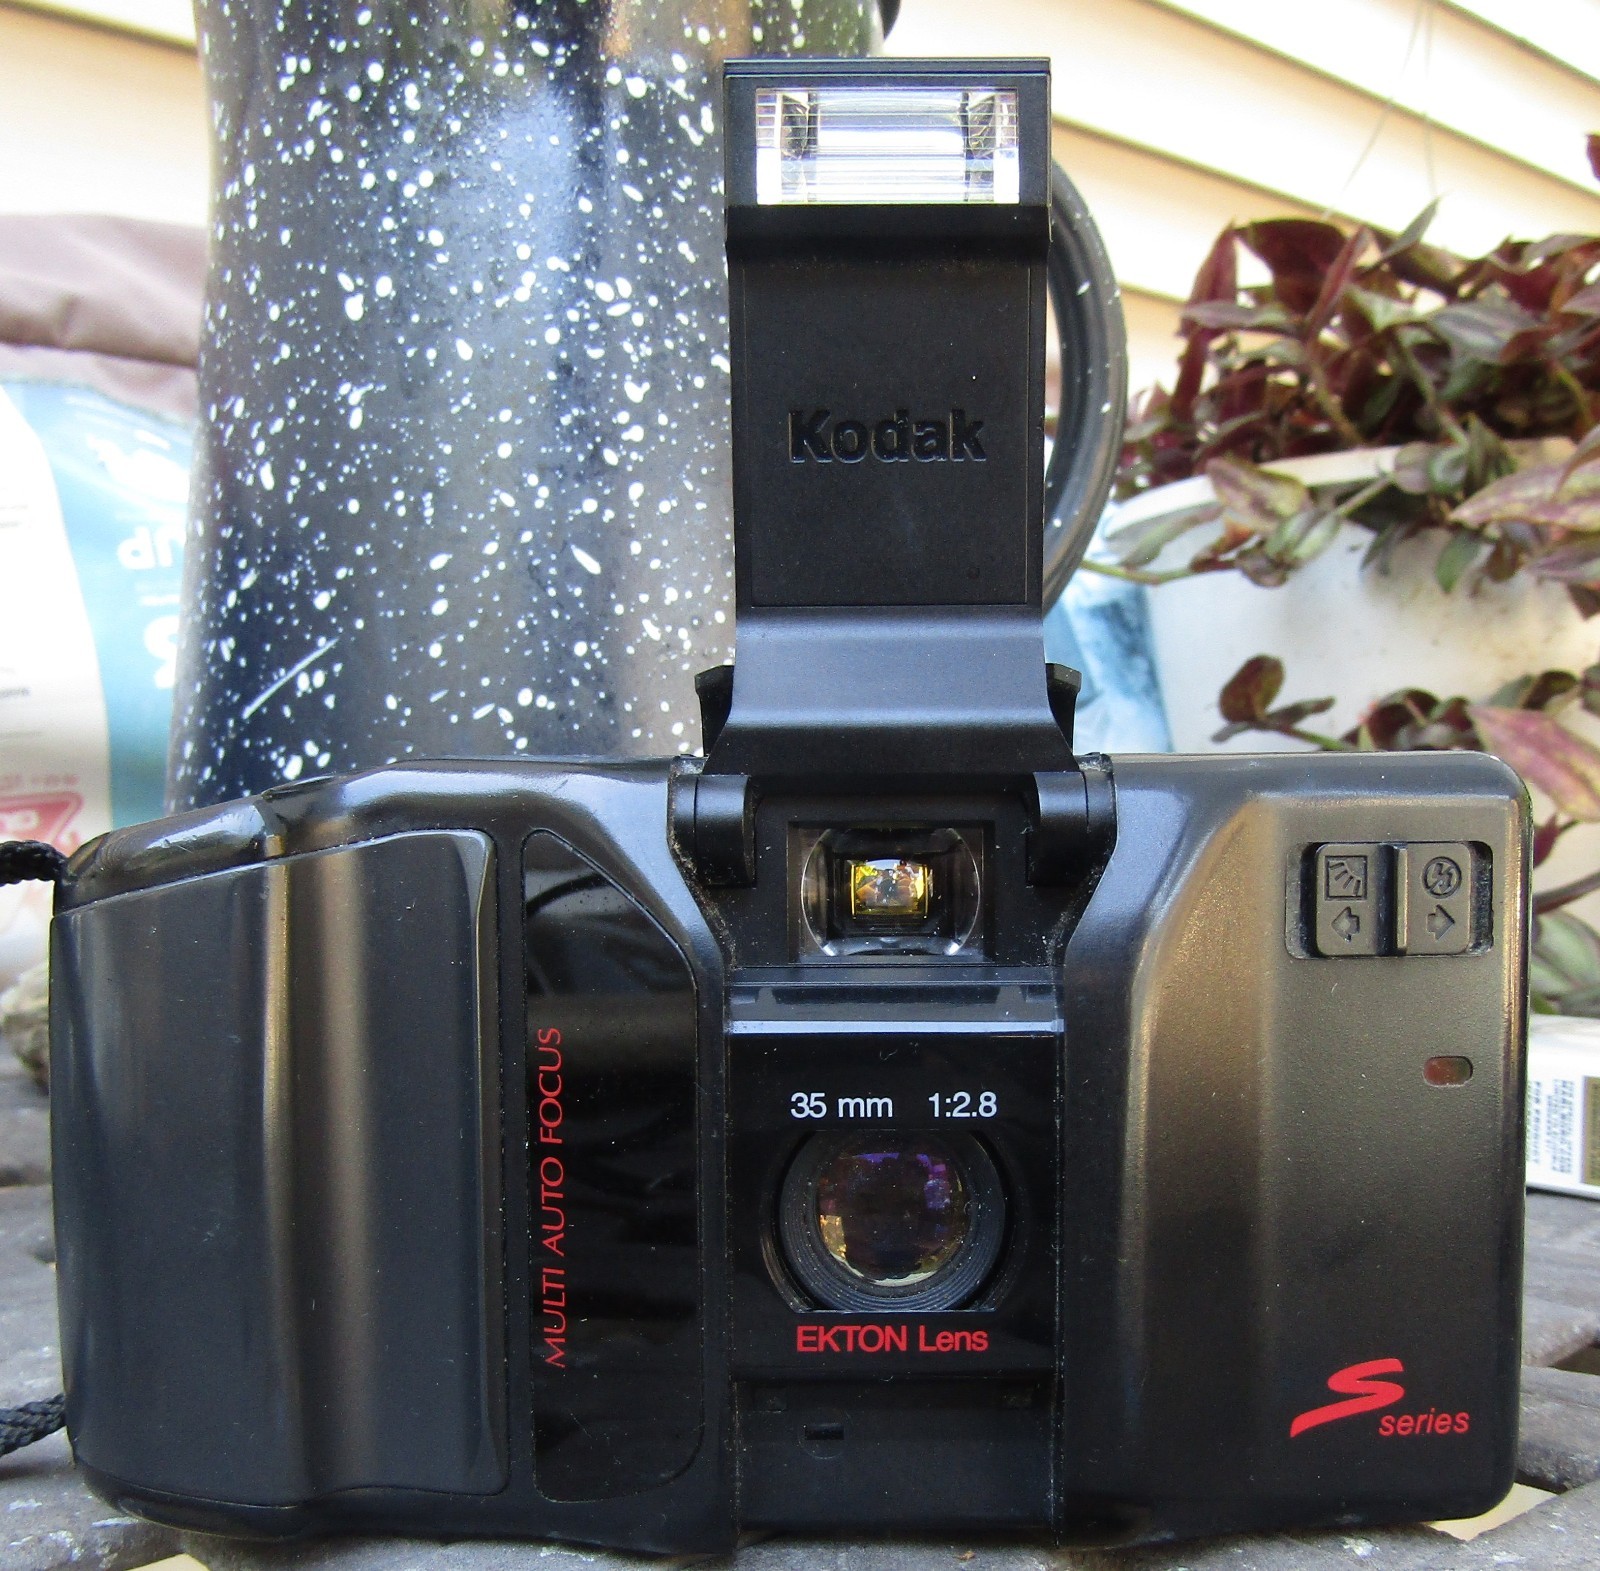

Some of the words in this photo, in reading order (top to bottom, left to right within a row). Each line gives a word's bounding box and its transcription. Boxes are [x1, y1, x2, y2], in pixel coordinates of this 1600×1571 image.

[788, 408, 987, 464] Kodak
[537, 1026, 564, 1144] FOCUS
[790, 1092, 828, 1119] 35
[838, 1096, 893, 1118] mm
[928, 1091, 998, 1118] 1:2.8
[539, 1156, 565, 1257] AUTO
[543, 1266, 567, 1369] MULTI
[796, 1324, 907, 1352] EKTON
[919, 1324, 989, 1352] Lens
[1378, 1407, 1470, 1437] series
